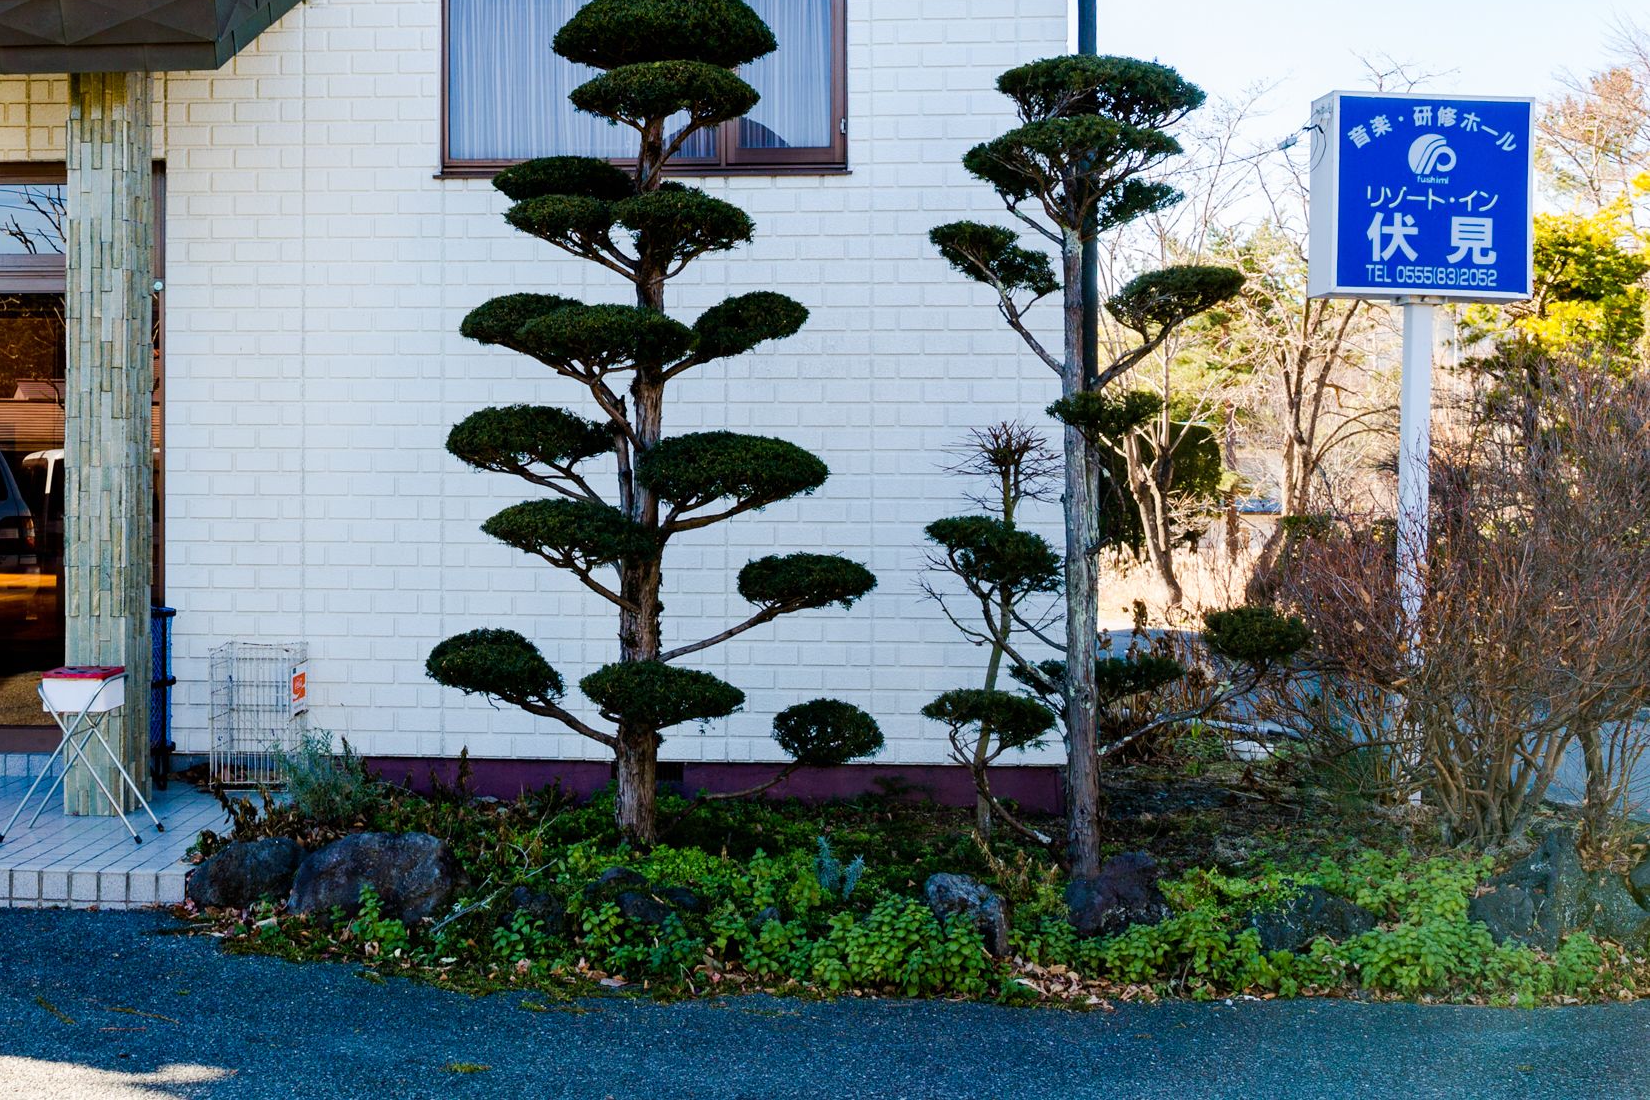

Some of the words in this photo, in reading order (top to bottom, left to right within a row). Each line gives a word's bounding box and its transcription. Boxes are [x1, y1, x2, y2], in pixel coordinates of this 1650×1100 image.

[1417, 175, 1449, 184] fushimi
[1366, 212, 1497, 265] 伏見
[1366, 265, 1392, 283] TEL
[1397, 266, 1497, 287] 0555(83)2052
